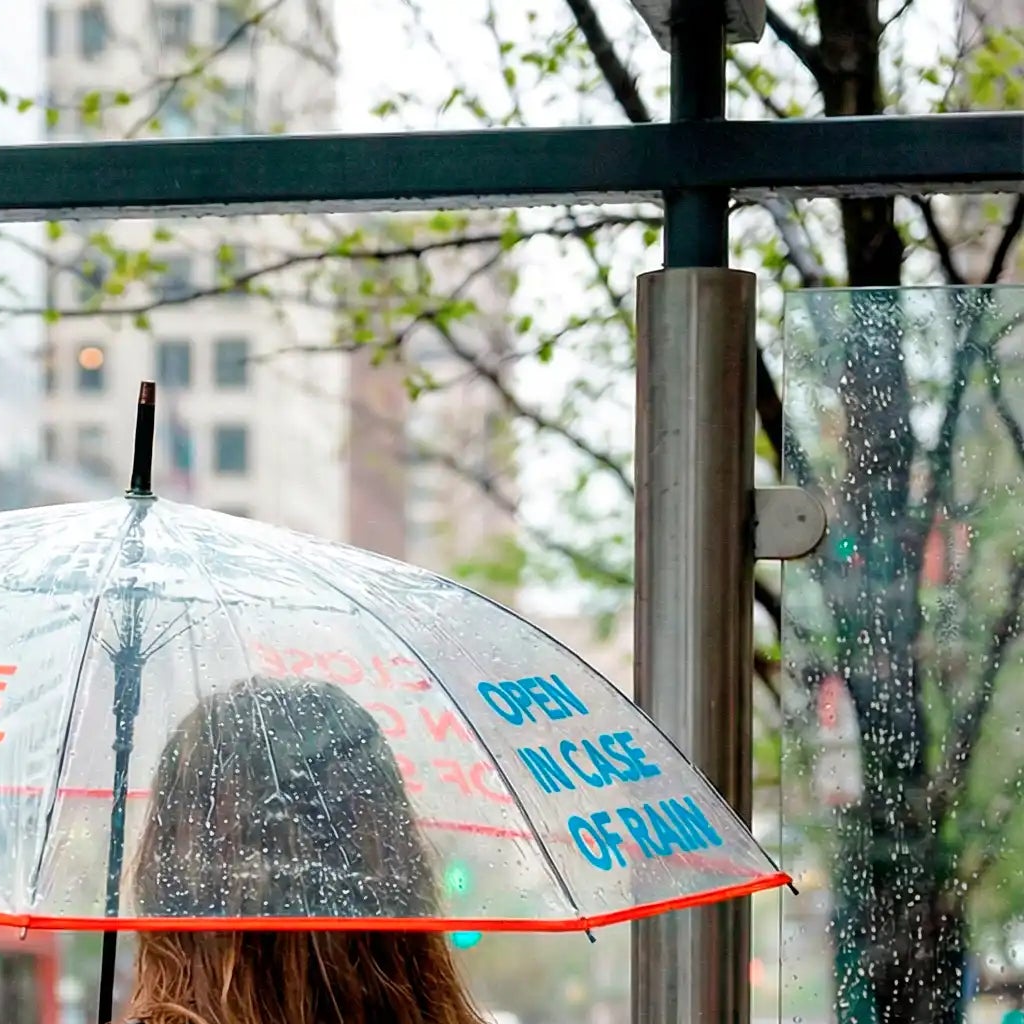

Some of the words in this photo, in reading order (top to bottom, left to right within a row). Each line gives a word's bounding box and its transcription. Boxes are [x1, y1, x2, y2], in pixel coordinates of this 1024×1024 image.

[477, 673, 590, 726] OPEN
[517, 746, 576, 794] IN
[559, 731, 662, 788] CASE
[567, 810, 627, 871] OF
[616, 796, 723, 859] RAIN
